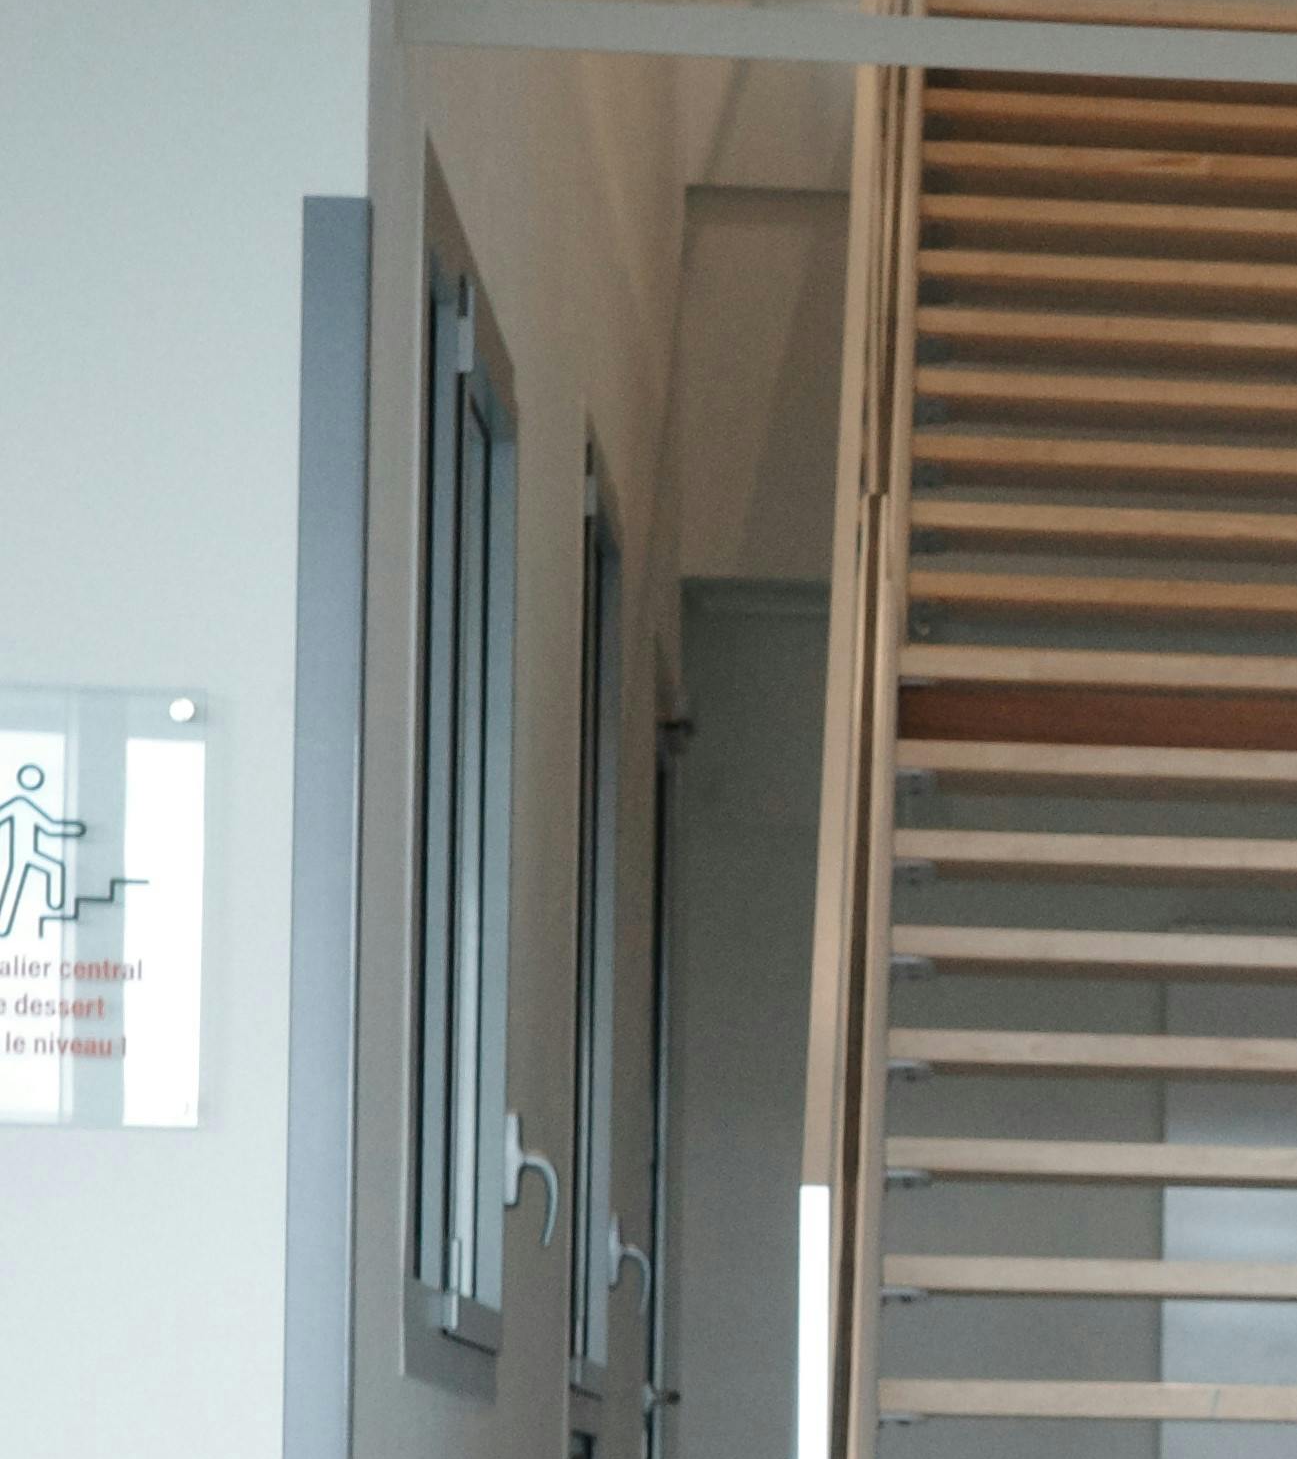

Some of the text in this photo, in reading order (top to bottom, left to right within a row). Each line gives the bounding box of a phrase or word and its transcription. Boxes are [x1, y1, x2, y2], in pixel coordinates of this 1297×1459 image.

[60, 958, 142, 981] central
[14, 993, 105, 1019] dessert
[33, 1032, 112, 1058] niveau
